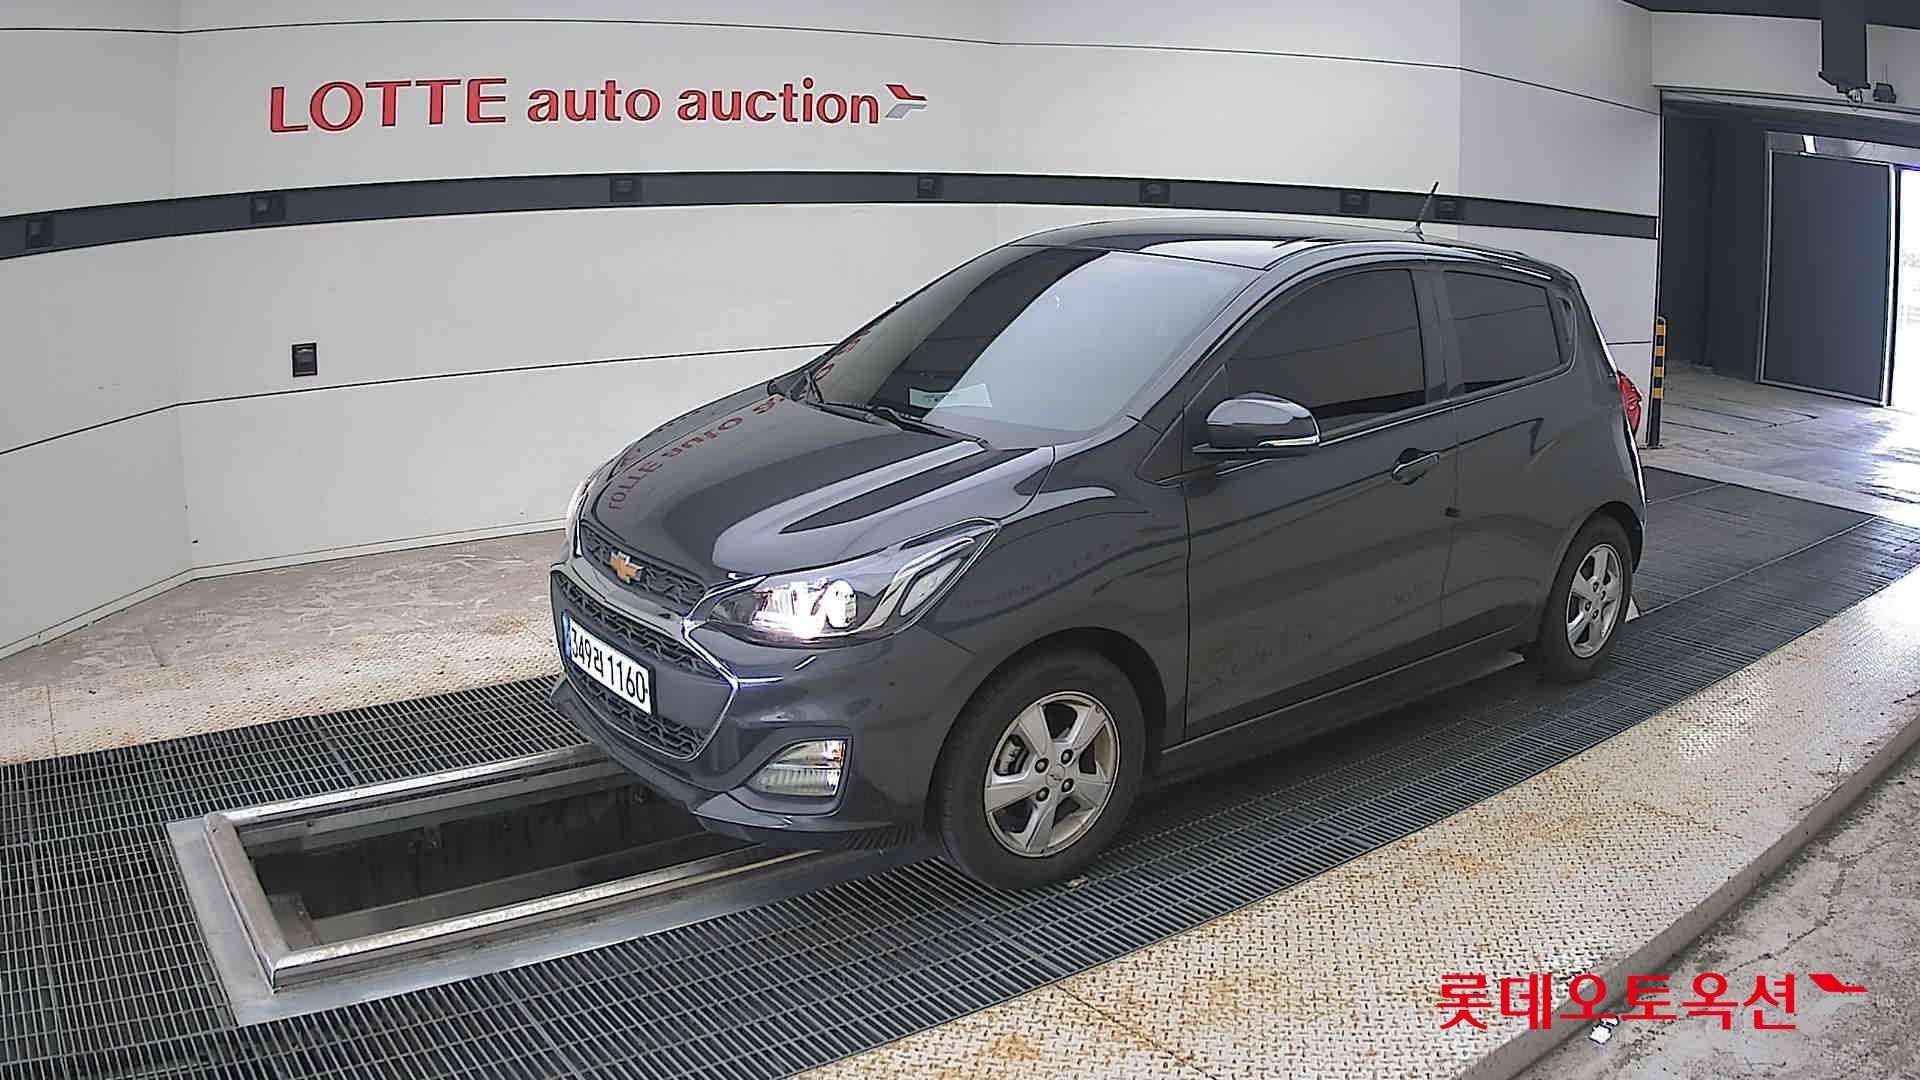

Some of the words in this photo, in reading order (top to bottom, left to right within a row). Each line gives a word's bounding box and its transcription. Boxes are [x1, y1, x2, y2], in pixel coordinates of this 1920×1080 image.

[270, 78, 506, 133] LOTTE
[527, 80, 662, 123] auto
[677, 77, 881, 124] auction
[607, 654, 646, 704] 1160
